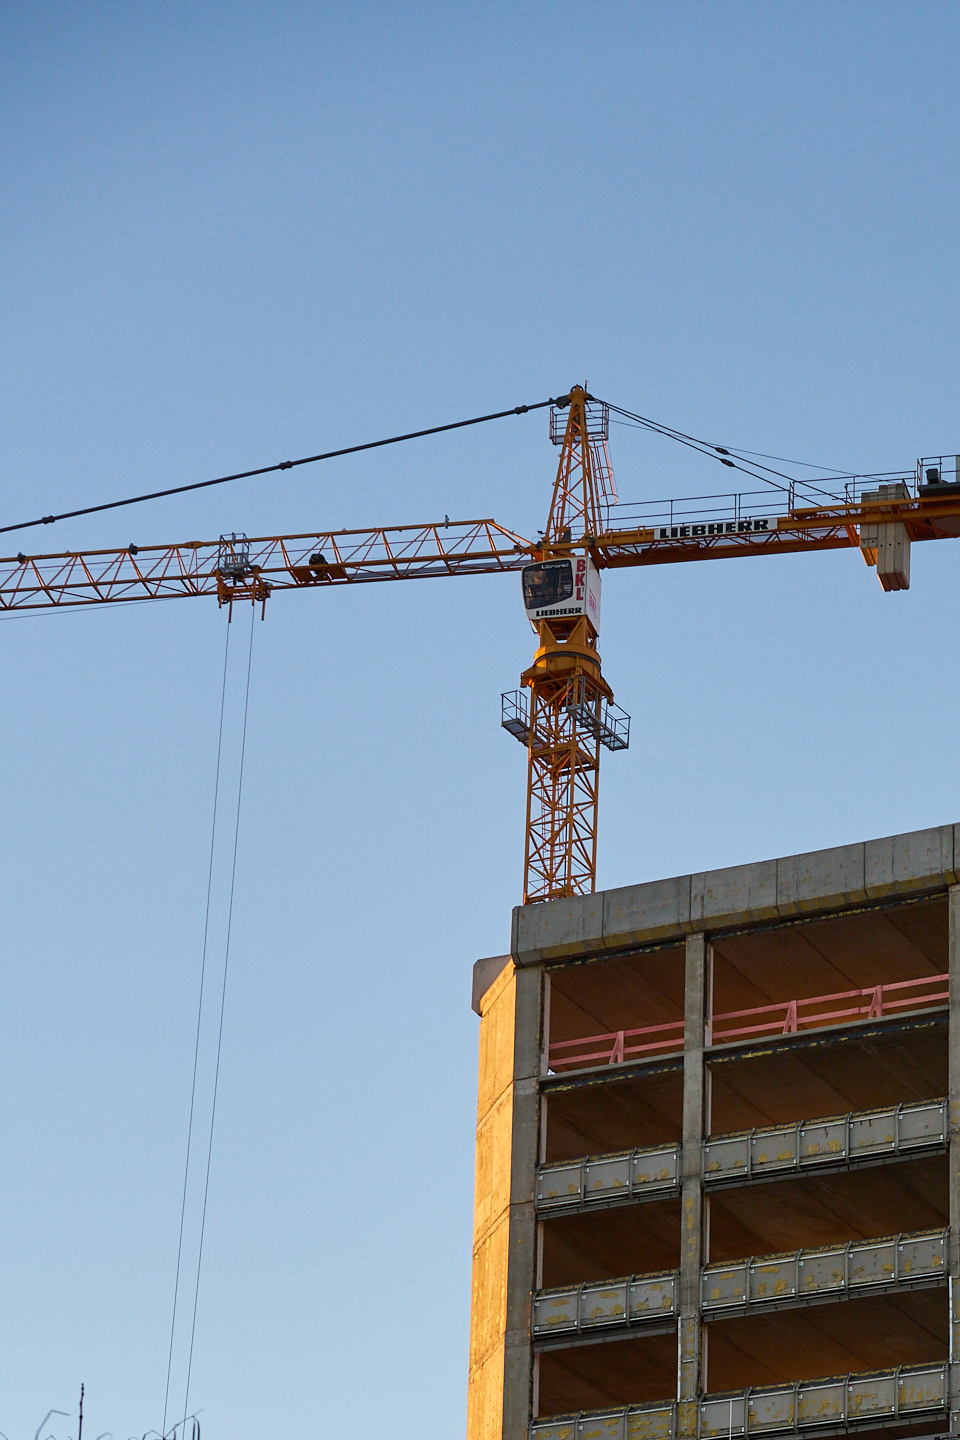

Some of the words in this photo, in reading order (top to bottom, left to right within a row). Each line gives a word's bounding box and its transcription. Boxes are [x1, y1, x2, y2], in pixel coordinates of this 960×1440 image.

[660, 519, 769, 539] LIEBHERR
[575, 559, 586, 601] BKL
[536, 607, 582, 617] LIEBHERR
